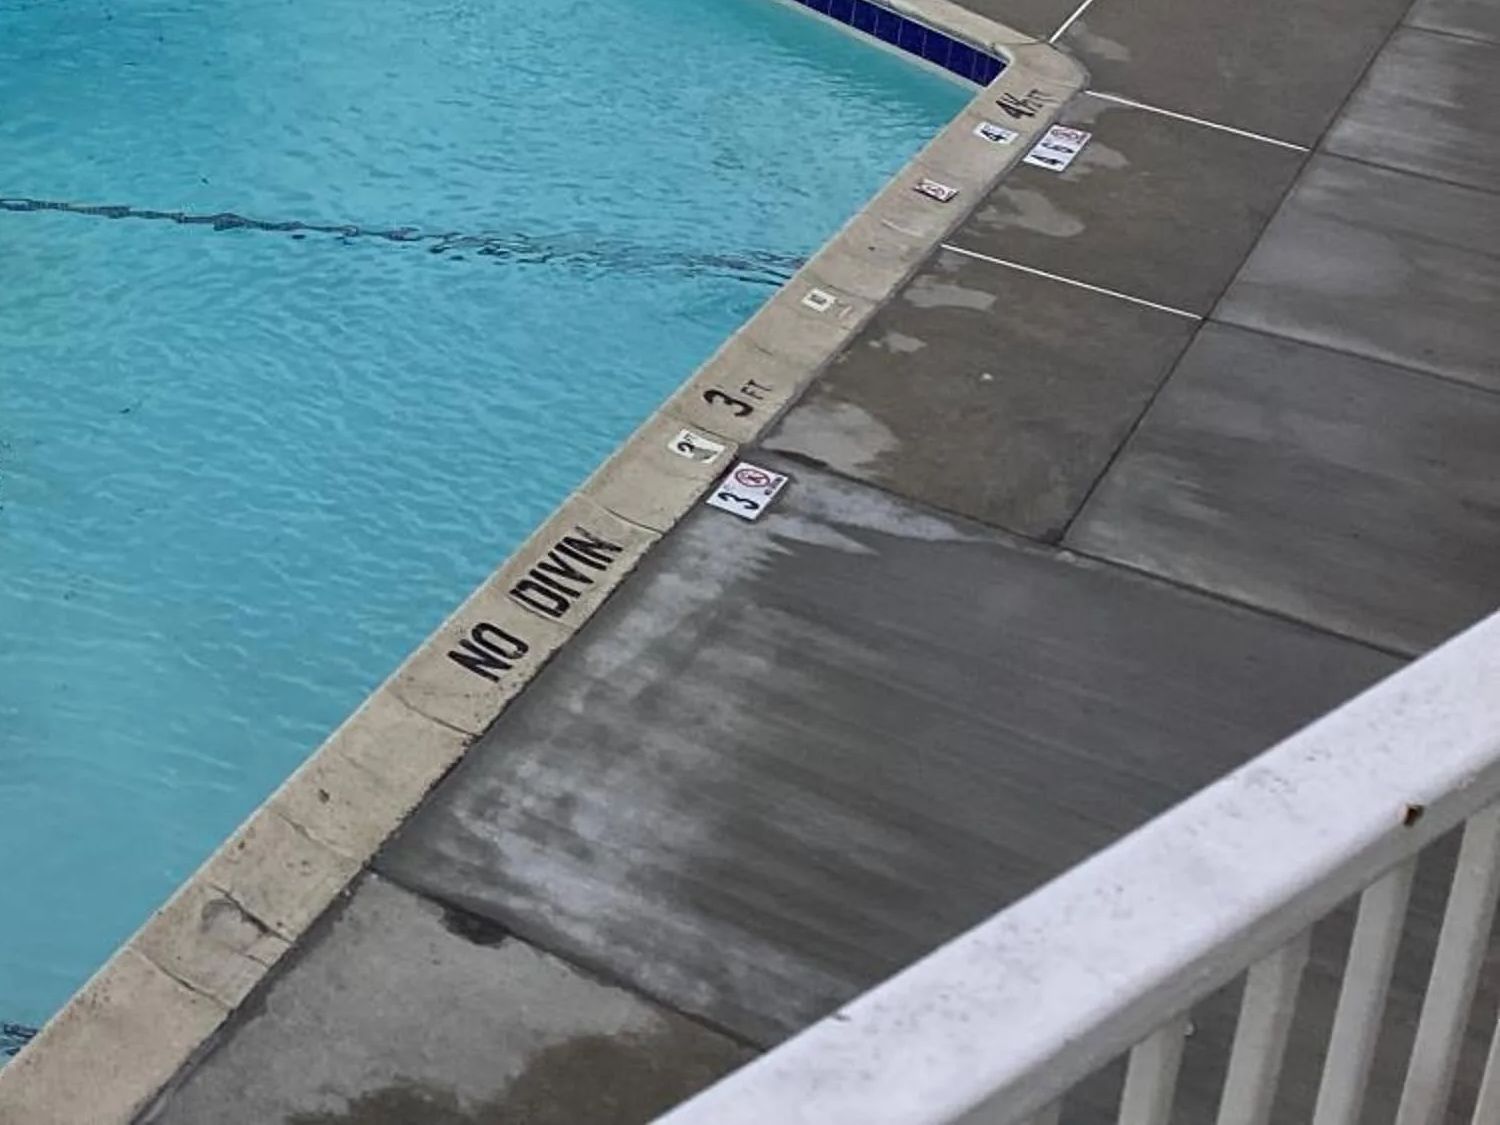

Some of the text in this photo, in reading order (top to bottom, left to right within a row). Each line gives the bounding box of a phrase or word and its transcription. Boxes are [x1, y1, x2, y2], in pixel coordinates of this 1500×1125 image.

[703, 378, 774, 418] 3 FT
[717, 491, 760, 510] 3
[446, 622, 530, 684] NO
